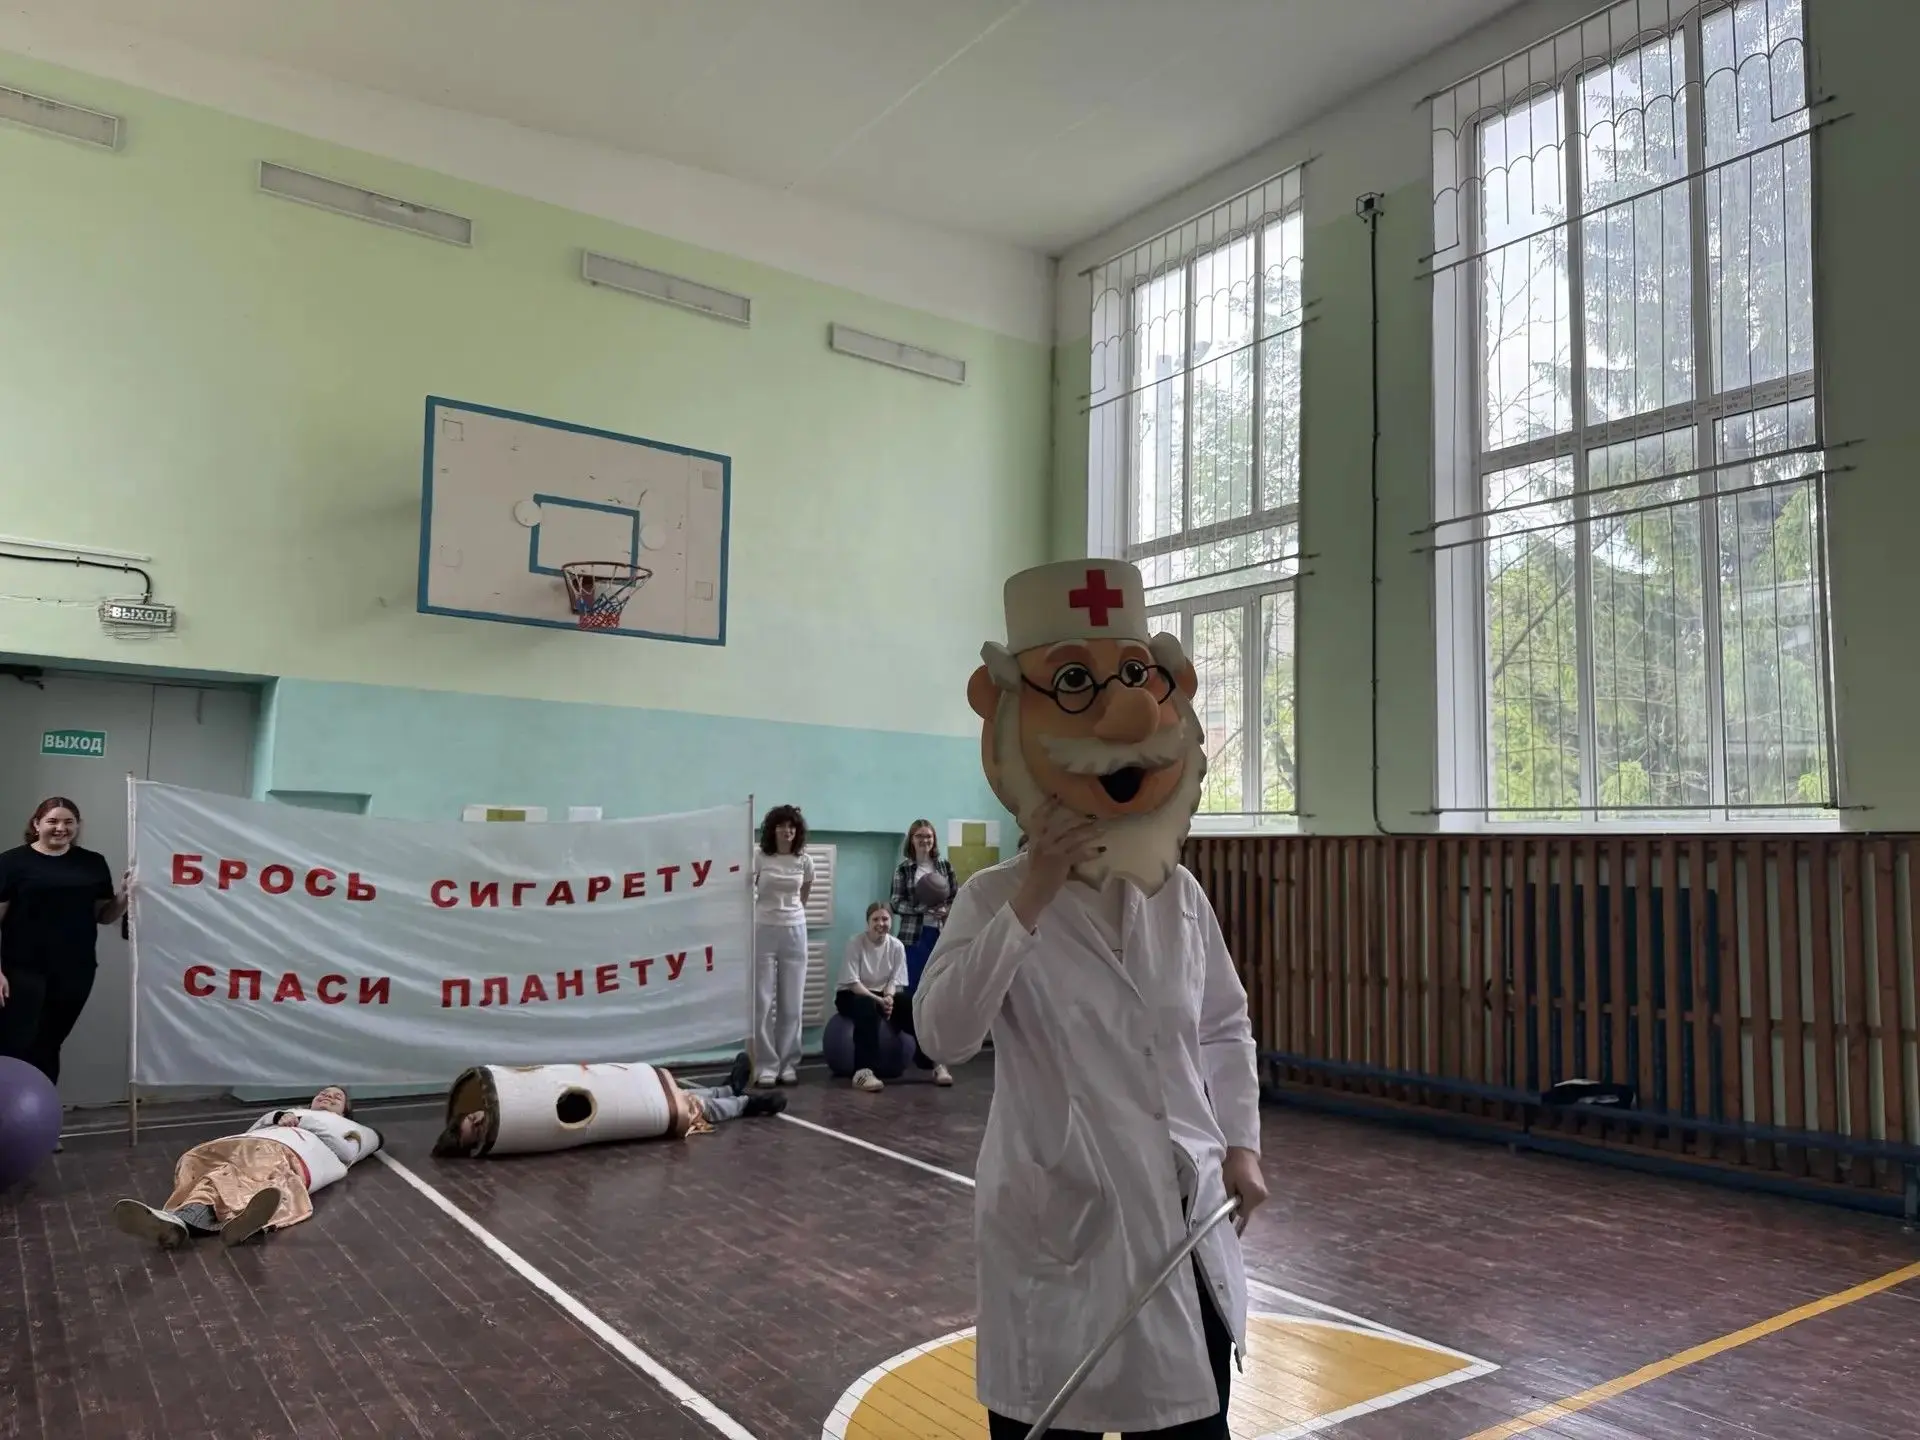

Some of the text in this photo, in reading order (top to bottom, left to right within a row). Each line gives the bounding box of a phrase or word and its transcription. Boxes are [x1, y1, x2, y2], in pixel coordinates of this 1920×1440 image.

[111, 606, 165, 623] ВЫХОД
[44, 734, 103, 753] ВЫХОД
[171, 854, 377, 901] БРОСЬ
[183, 945, 714, 1008] СПАСИ ПЛАНЕТУ!
